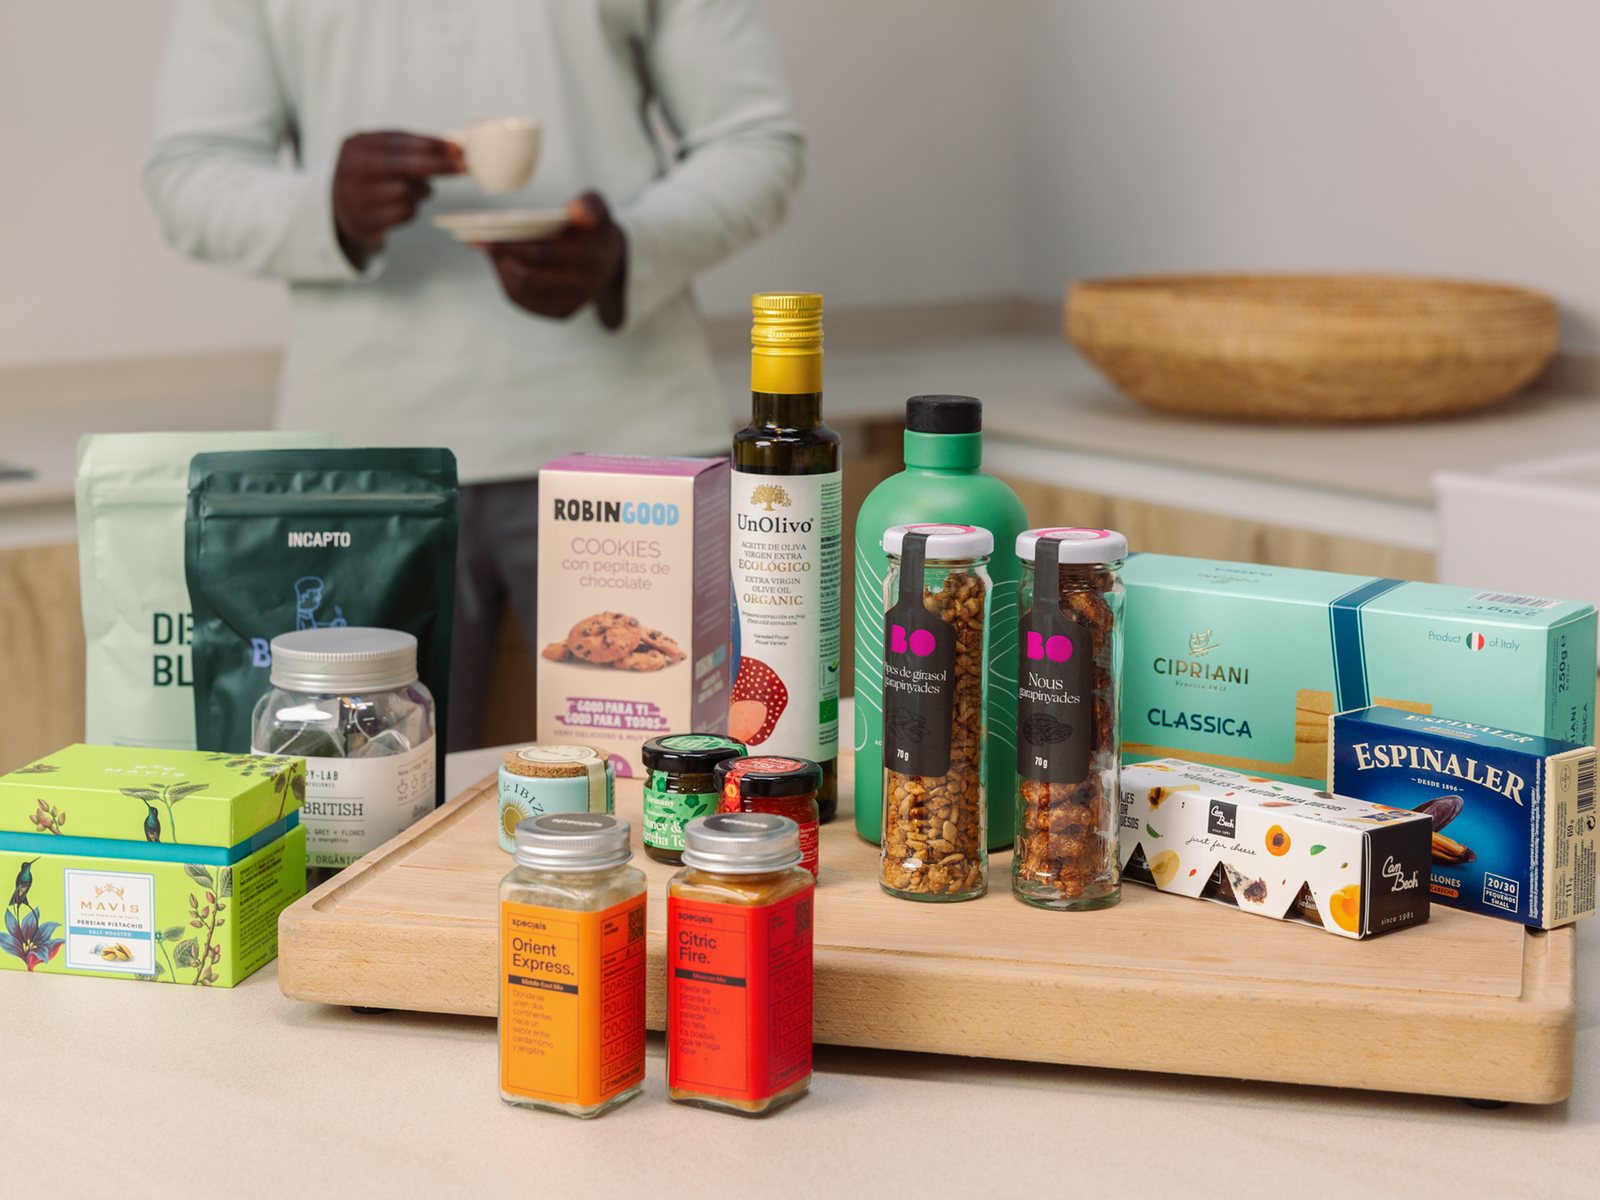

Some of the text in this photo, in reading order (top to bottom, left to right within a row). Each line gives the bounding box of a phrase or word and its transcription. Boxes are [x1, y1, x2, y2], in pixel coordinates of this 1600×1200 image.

[554, 498, 680, 526] ROBINGOOD
[288, 531, 351, 548] INCAPTO
[571, 537, 662, 559] COOKIES
[742, 541, 767, 550] ACEITE
[780, 543, 807, 551] OLIVA
[744, 550, 802, 560] VIRGEN EXTRA
[561, 559, 671, 575] con pepitas de
[738, 558, 811, 573] ECOLÓGICO
[579, 573, 653, 590] chocolate
[745, 575, 801, 585] EXTRA VIRGIN
[752, 585, 791, 594] OLIVE OIL
[743, 593, 803, 606] ORGANIC
[891, 623, 937, 657] BO
[1027, 631, 1073, 663] BO
[1428, 630, 1520, 652] Product of Italy
[899, 666, 912, 678] de
[912, 669, 947, 683] girasol
[1153, 657, 1249, 685] CIPRIANI
[1558, 650, 1569, 693] 250g
[1028, 671, 1064, 690] Nous
[576, 700, 650, 716] GOOD PARA TI
[564, 713, 662, 730] GOOD PARA TODOS
[1147, 708, 1253, 739] CLASSICA
[1352, 741, 1526, 807] ESPINALER
[1417, 778, 1458, 792] DESDE 1896
[303, 801, 363, 816] BRITISH
[1210, 805, 1224, 817] Can
[671, 821, 683, 834] &
[1217, 814, 1235, 829] Bech
[341, 828, 366, 837] FLORES
[643, 831, 668, 847] atcha
[1567, 824, 1574, 838] 69
[1185, 835, 1257, 856] just for cheese
[1382, 855, 1401, 878] Can
[1391, 870, 1419, 892] Bech
[1487, 877, 1516, 894] 20/30
[80, 900, 140, 913] MAVIS
[1491, 898, 1510, 908] SMALL
[77, 919, 143, 929] PERSIAN PISTACHIO
[512, 919, 547, 930] specials
[1381, 911, 1414, 926] since 1981
[512, 937, 557, 957] Orient
[678, 931, 717, 950] Citric
[679, 946, 711, 965] Fire.
[513, 953, 575, 976] Express.
